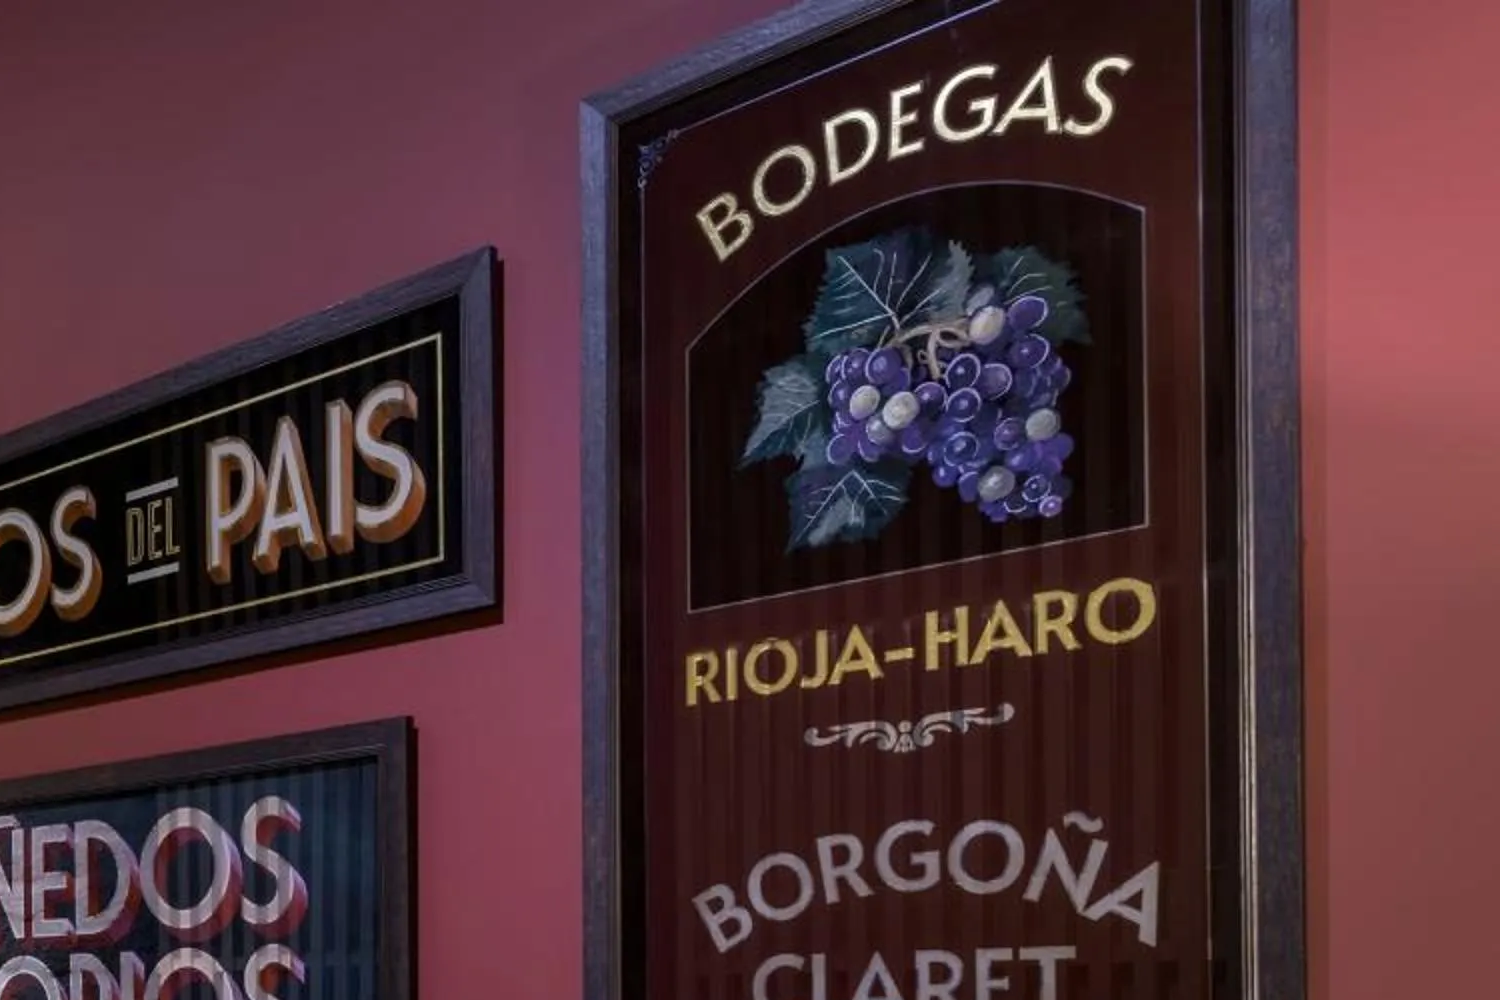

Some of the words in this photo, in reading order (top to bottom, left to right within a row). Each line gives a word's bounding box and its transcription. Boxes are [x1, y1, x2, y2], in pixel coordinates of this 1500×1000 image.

[696, 55, 1134, 262] BODEGAS
[127, 495, 180, 566] DEL
[206, 380, 426, 584] PAIS
[685, 577, 1157, 707] RIOJA-HARO
[691, 811, 1160, 948] BORGOÑA
